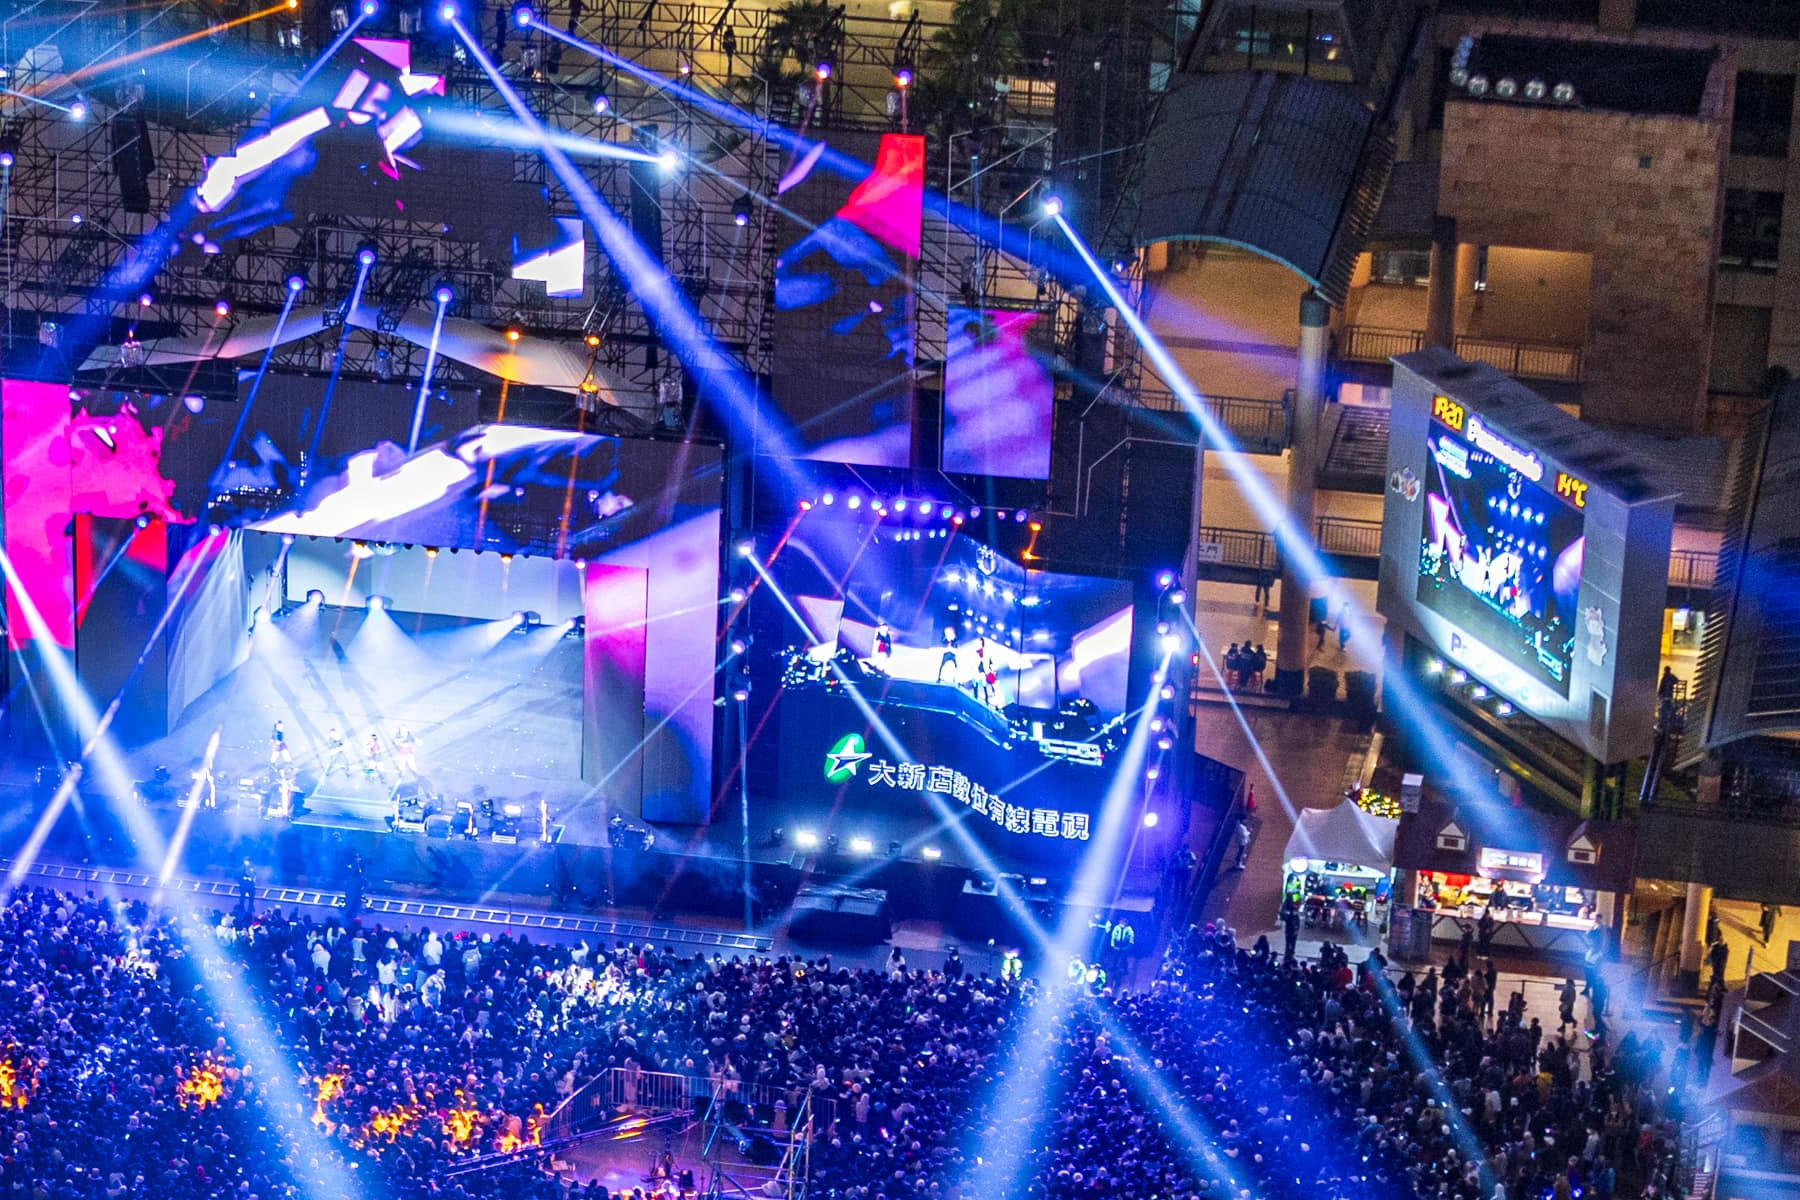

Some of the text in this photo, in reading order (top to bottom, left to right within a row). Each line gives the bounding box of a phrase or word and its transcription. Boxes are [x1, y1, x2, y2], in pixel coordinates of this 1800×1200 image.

[868, 759, 1090, 841] 大新店數位有線電視
